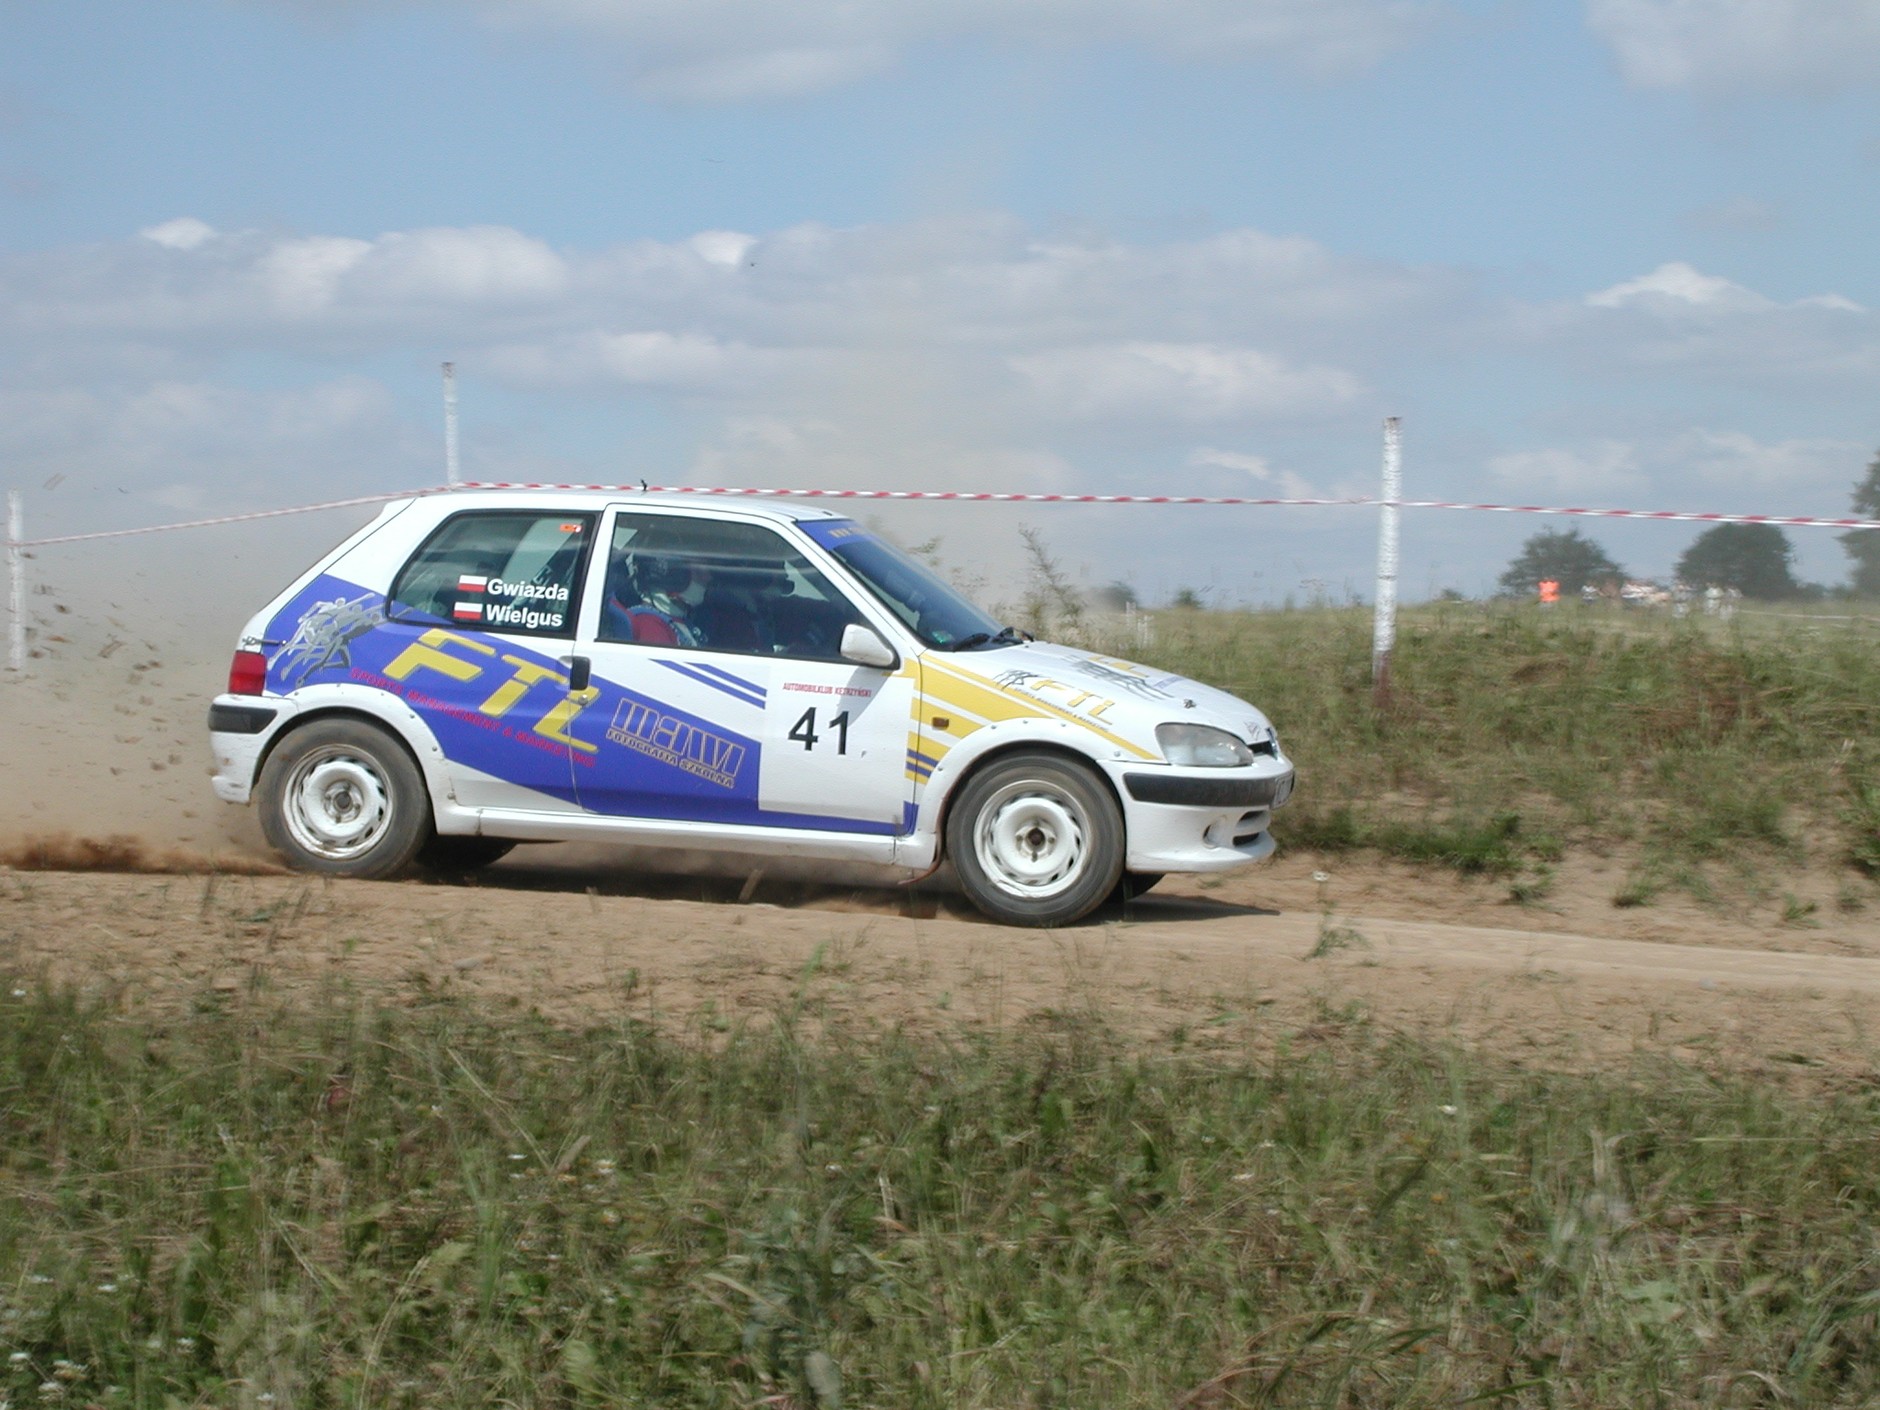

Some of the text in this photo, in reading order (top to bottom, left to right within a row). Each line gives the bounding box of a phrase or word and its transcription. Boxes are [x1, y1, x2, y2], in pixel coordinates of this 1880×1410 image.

[487, 578, 569, 601] Gwiazda
[486, 604, 563, 629] Wielgus
[787, 706, 849, 755] 41
